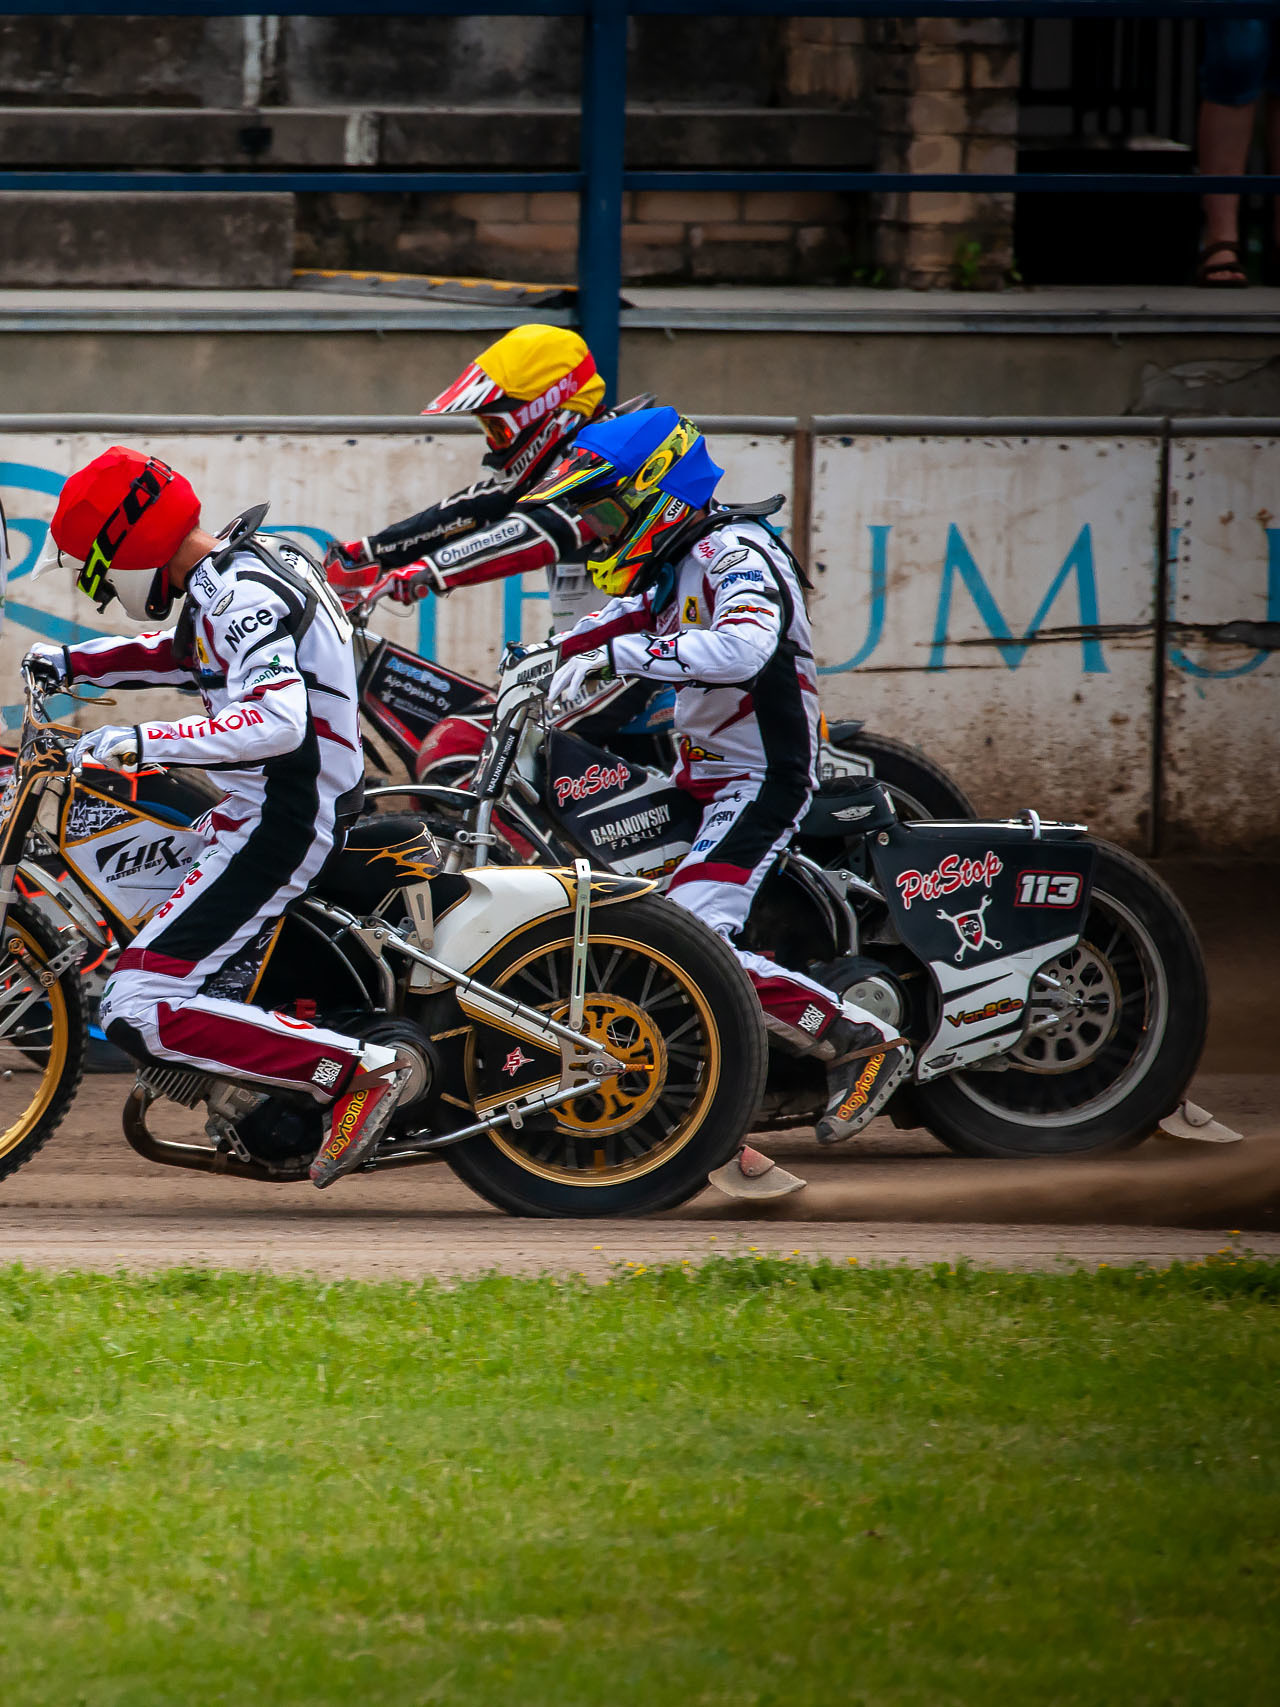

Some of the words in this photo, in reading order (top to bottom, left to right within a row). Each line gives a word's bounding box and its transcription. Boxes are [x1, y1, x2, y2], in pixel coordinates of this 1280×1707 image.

[516, 373, 578, 427] 100%
[666, 500, 683, 519] SHO
[224, 609, 274, 653] Nice
[553, 762, 632, 808] PitStop
[590, 804, 672, 847] BARANOWSKY
[611, 825, 663, 852] FAMILY
[106, 865, 142, 883] FASTEST
[144, 858, 164, 871] WAY
[896, 850, 1003, 910] PitStop
[1020, 874, 1080, 905] 113
[944, 996, 1024, 1028] Van2Go
[836, 1053, 885, 1121] daytona
